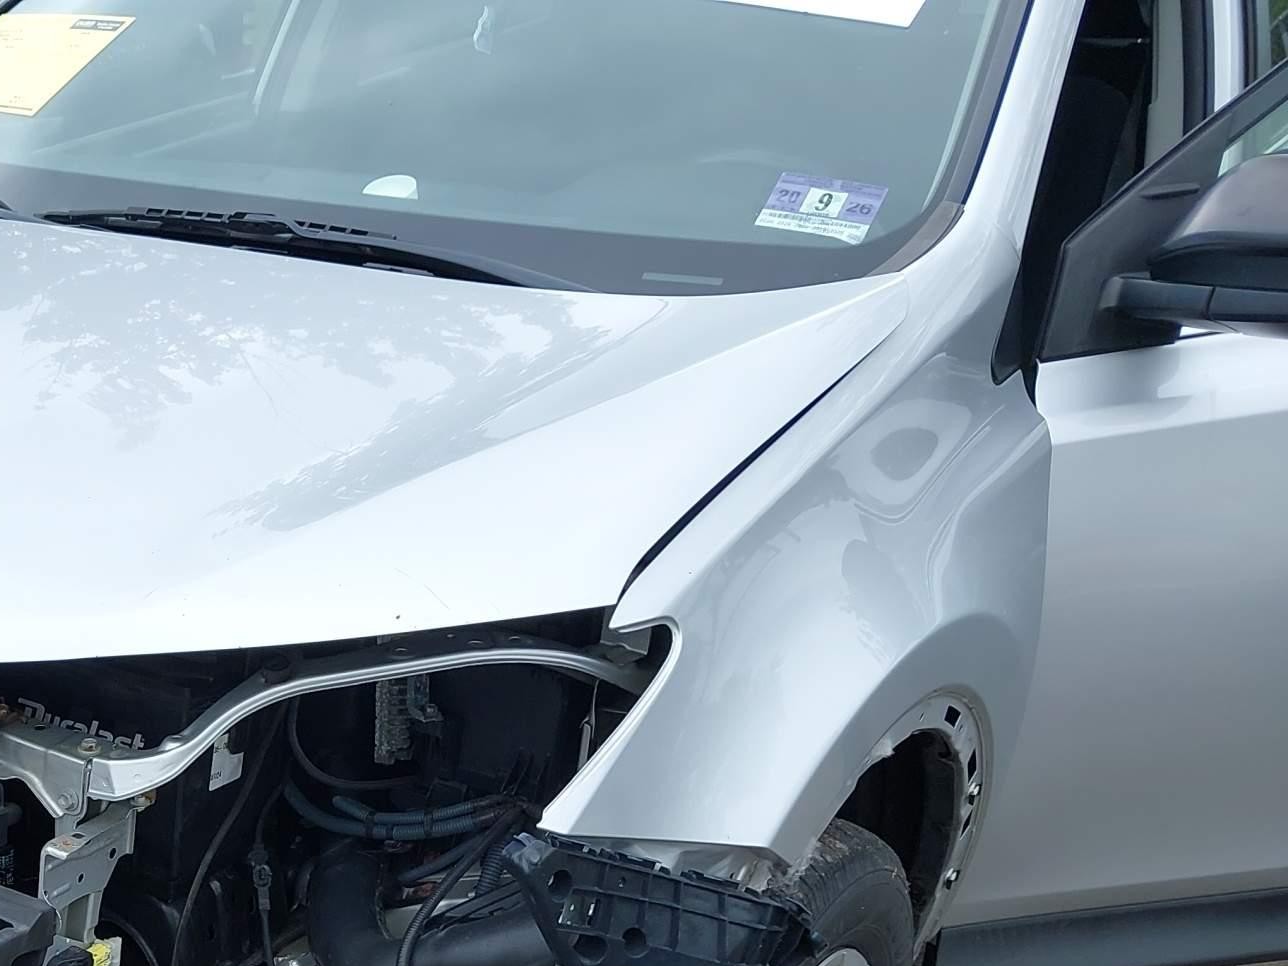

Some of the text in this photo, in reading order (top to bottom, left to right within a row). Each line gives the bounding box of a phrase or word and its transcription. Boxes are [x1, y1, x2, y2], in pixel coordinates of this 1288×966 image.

[775, 189, 873, 216] 20 9 26
